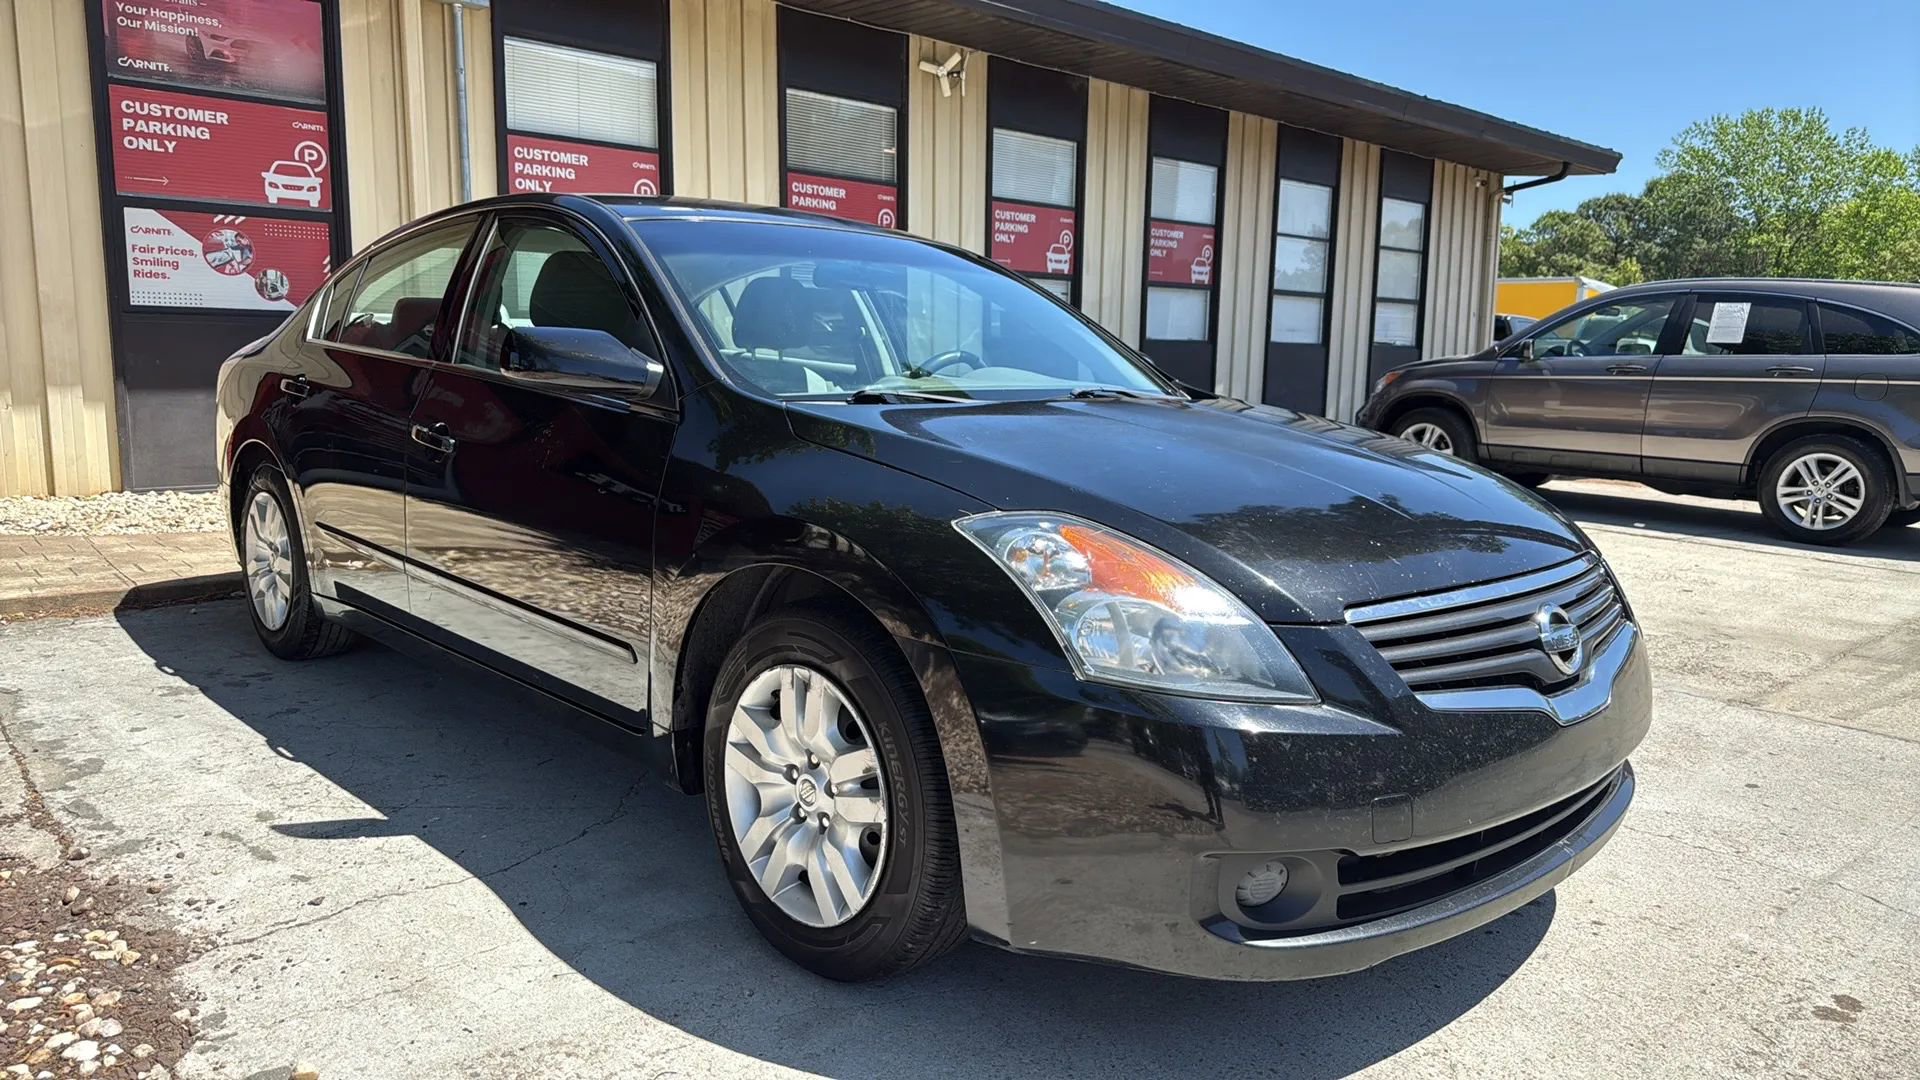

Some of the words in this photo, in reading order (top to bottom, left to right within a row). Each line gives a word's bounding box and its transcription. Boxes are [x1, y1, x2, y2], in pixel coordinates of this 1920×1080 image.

[115, 1, 147, 15] Your
[150, 7, 222, 28] Happiness,
[117, 16, 142, 28] Our
[144, 21, 198, 37] Mission!
[120, 100, 229, 125] CUSTOMER
[122, 118, 210, 140] PARKING
[123, 136, 177, 153] ONLY
[513, 146, 589, 166] CUSTOMER
[514, 162, 576, 180] PARKING
[514, 178, 552, 193] ONLY
[791, 182, 847, 199] CUSTOMER
[791, 195, 837, 210] PARKING
[994, 209, 1037, 223] CUSTOMER
[994, 221, 1029, 234] PARKING
[1150, 228, 1184, 240] CUSTOMER
[994, 233, 1016, 243] ONLY
[1150, 238, 1178, 249] PARKING
[131, 244, 156, 254] Fair
[157, 246, 198, 258] Prices,
[132, 256, 180, 270] Smiling
[133, 269, 171, 280] Rides.
